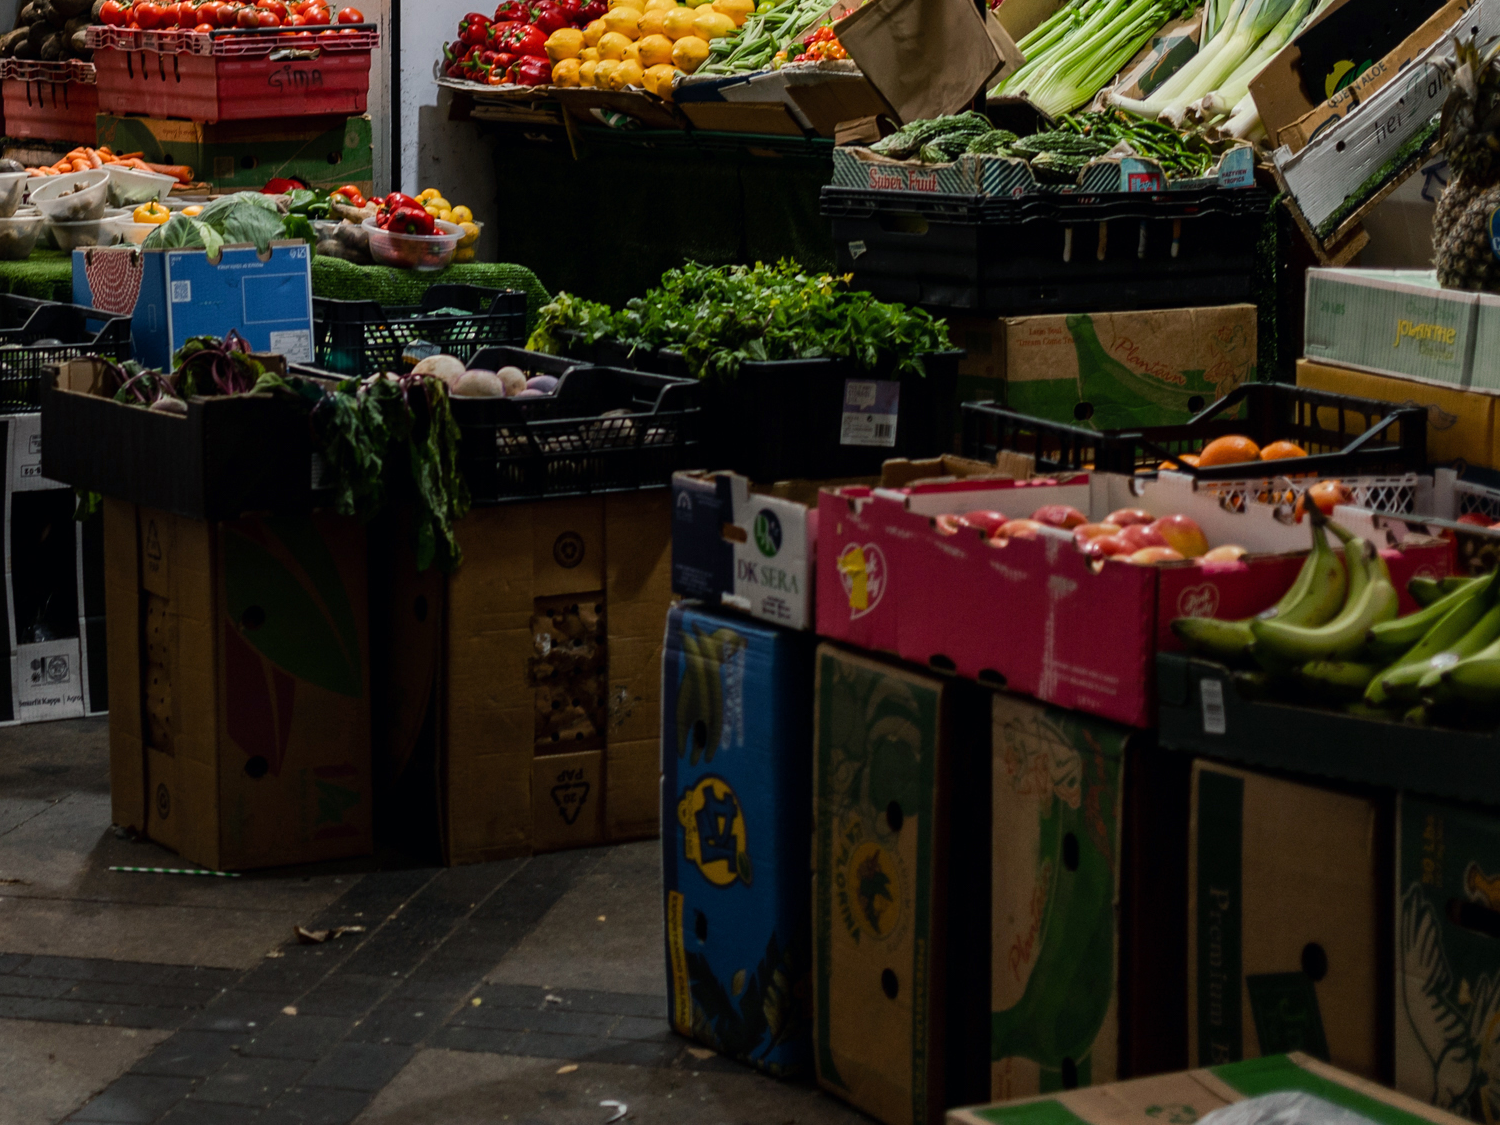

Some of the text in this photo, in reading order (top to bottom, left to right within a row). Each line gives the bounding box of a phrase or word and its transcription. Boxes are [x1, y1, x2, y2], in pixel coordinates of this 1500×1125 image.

[1362, 61, 1388, 89] ALOE
[868, 169, 938, 192] Super Fruit
[1114, 335, 1187, 389] Plantain
[737, 559, 758, 584] DK
[760, 565, 800, 595] SERA
[1208, 884, 1230, 1027] Premium
